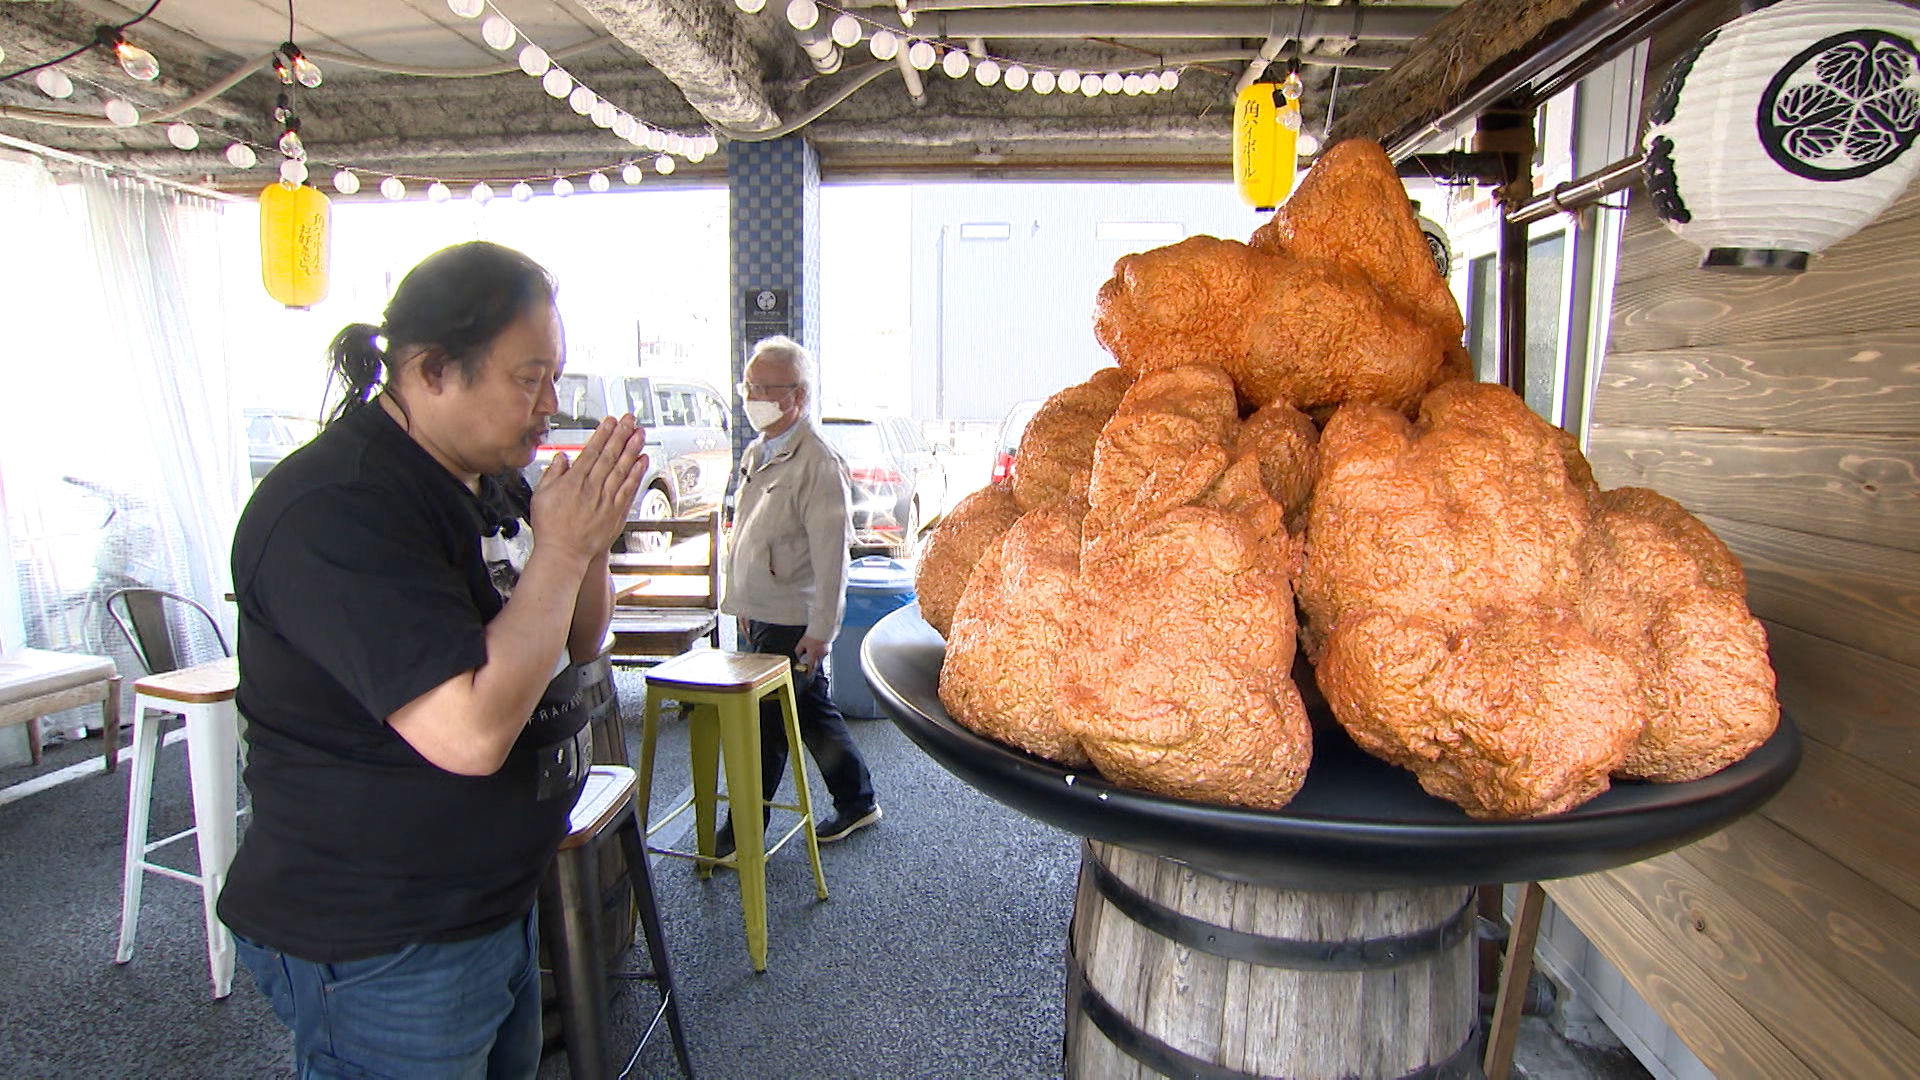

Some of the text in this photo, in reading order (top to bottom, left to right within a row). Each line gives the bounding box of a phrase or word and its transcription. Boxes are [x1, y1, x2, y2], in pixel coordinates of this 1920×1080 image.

[1243, 99, 1260, 178] 角ハイボール
